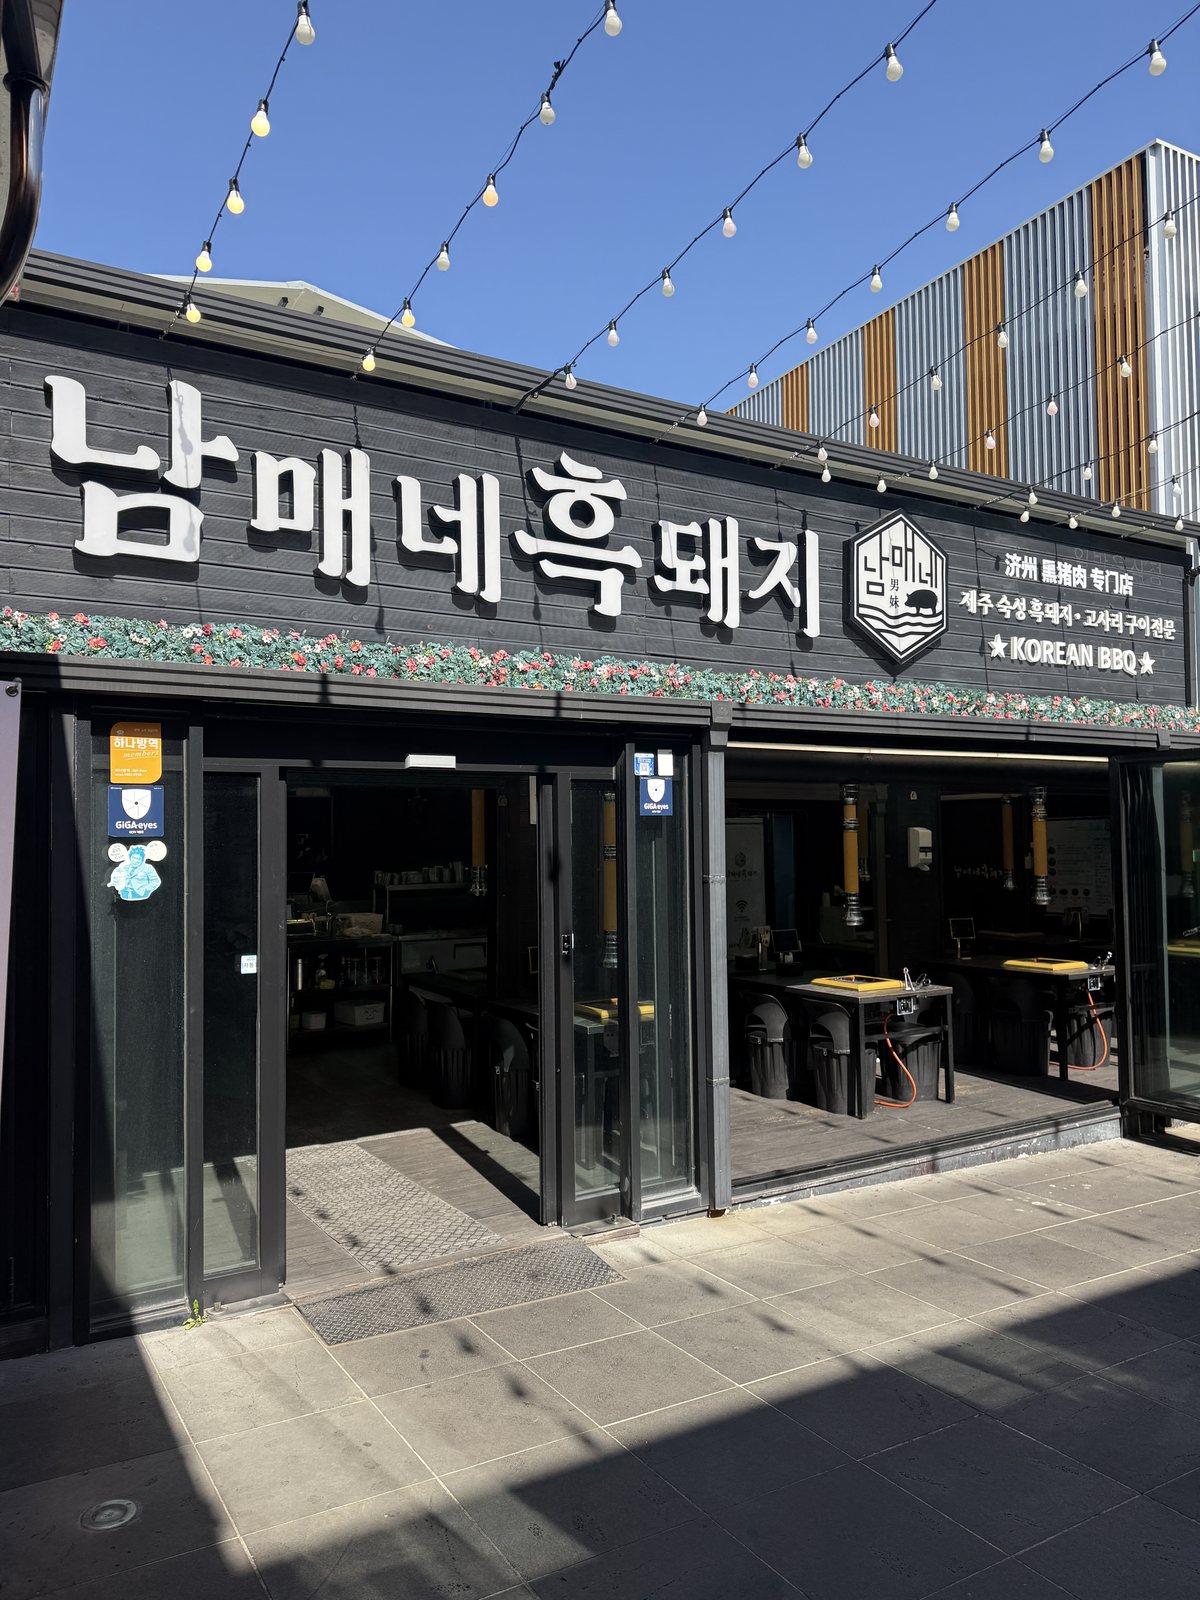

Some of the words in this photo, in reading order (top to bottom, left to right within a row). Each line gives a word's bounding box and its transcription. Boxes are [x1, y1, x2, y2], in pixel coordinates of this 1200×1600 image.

[863, 520, 938, 597] 남매네
[1005, 552, 1038, 581] 济州
[1089, 566, 1134, 597] 专门店
[959, 588, 994, 616] 제주
[995, 594, 1027, 621] 숙성
[1010, 635, 1094, 667] KOREAN
[1097, 645, 1138, 676] BBQ
[113, 737, 159, 750] 하나방역
